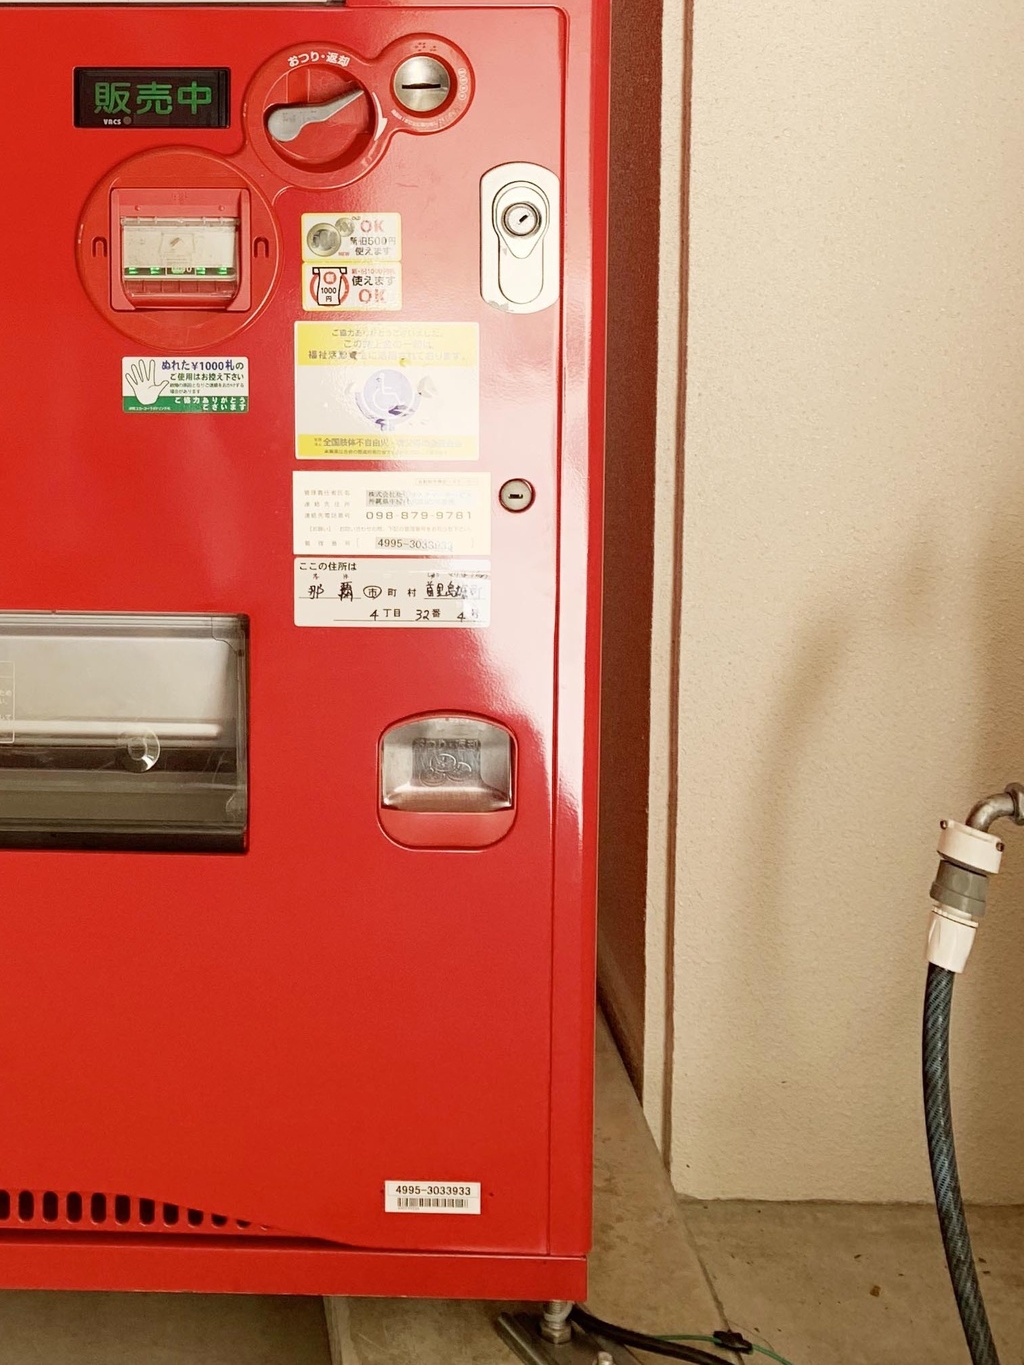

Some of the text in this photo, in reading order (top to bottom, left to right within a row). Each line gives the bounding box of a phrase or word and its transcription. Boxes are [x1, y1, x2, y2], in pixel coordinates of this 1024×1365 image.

[288, 51, 351, 67] おつり・返却
[94, 81, 212, 115] 販売中
[161, 359, 244, 371] ぬれた¥1000札の
[170, 373, 244, 381] ご使用はお控え下さい
[366, 511, 472, 520] 098-879-9781
[299, 562, 357, 571] ここの住所は
[383, 608, 401, 617] 丁目
[415, 610, 430, 621] 32
[395, 1185, 471, 1196] 4995-3033933
